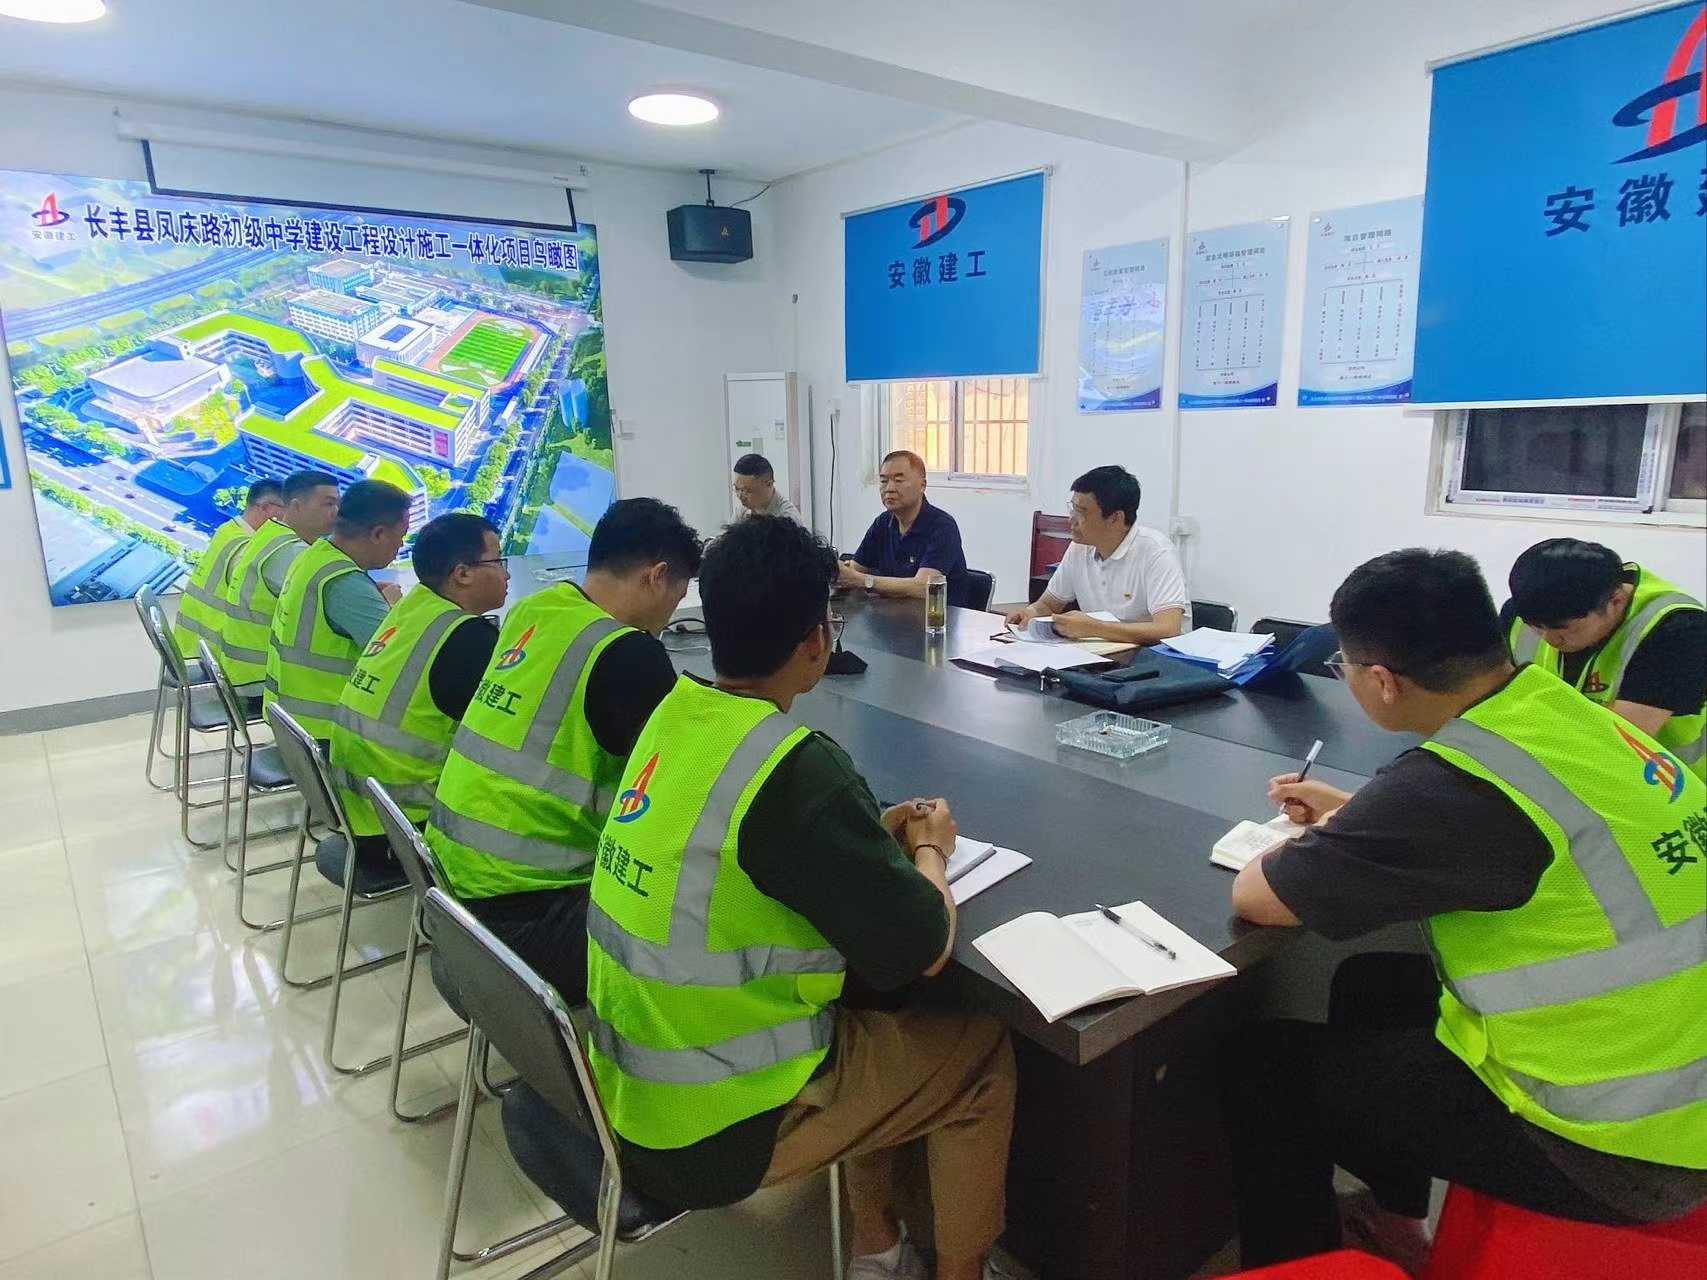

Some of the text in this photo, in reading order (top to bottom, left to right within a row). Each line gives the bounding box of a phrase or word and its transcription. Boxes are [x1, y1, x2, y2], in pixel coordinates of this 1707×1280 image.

[1543, 169, 1707, 237] 安徽
[84, 203, 579, 271] 长丰县凤庆路初级中学建设工程设计施工一体化项目鸟瞰图
[887, 250, 987, 290] 安徽建工
[597, 832, 653, 898] 徽建工
